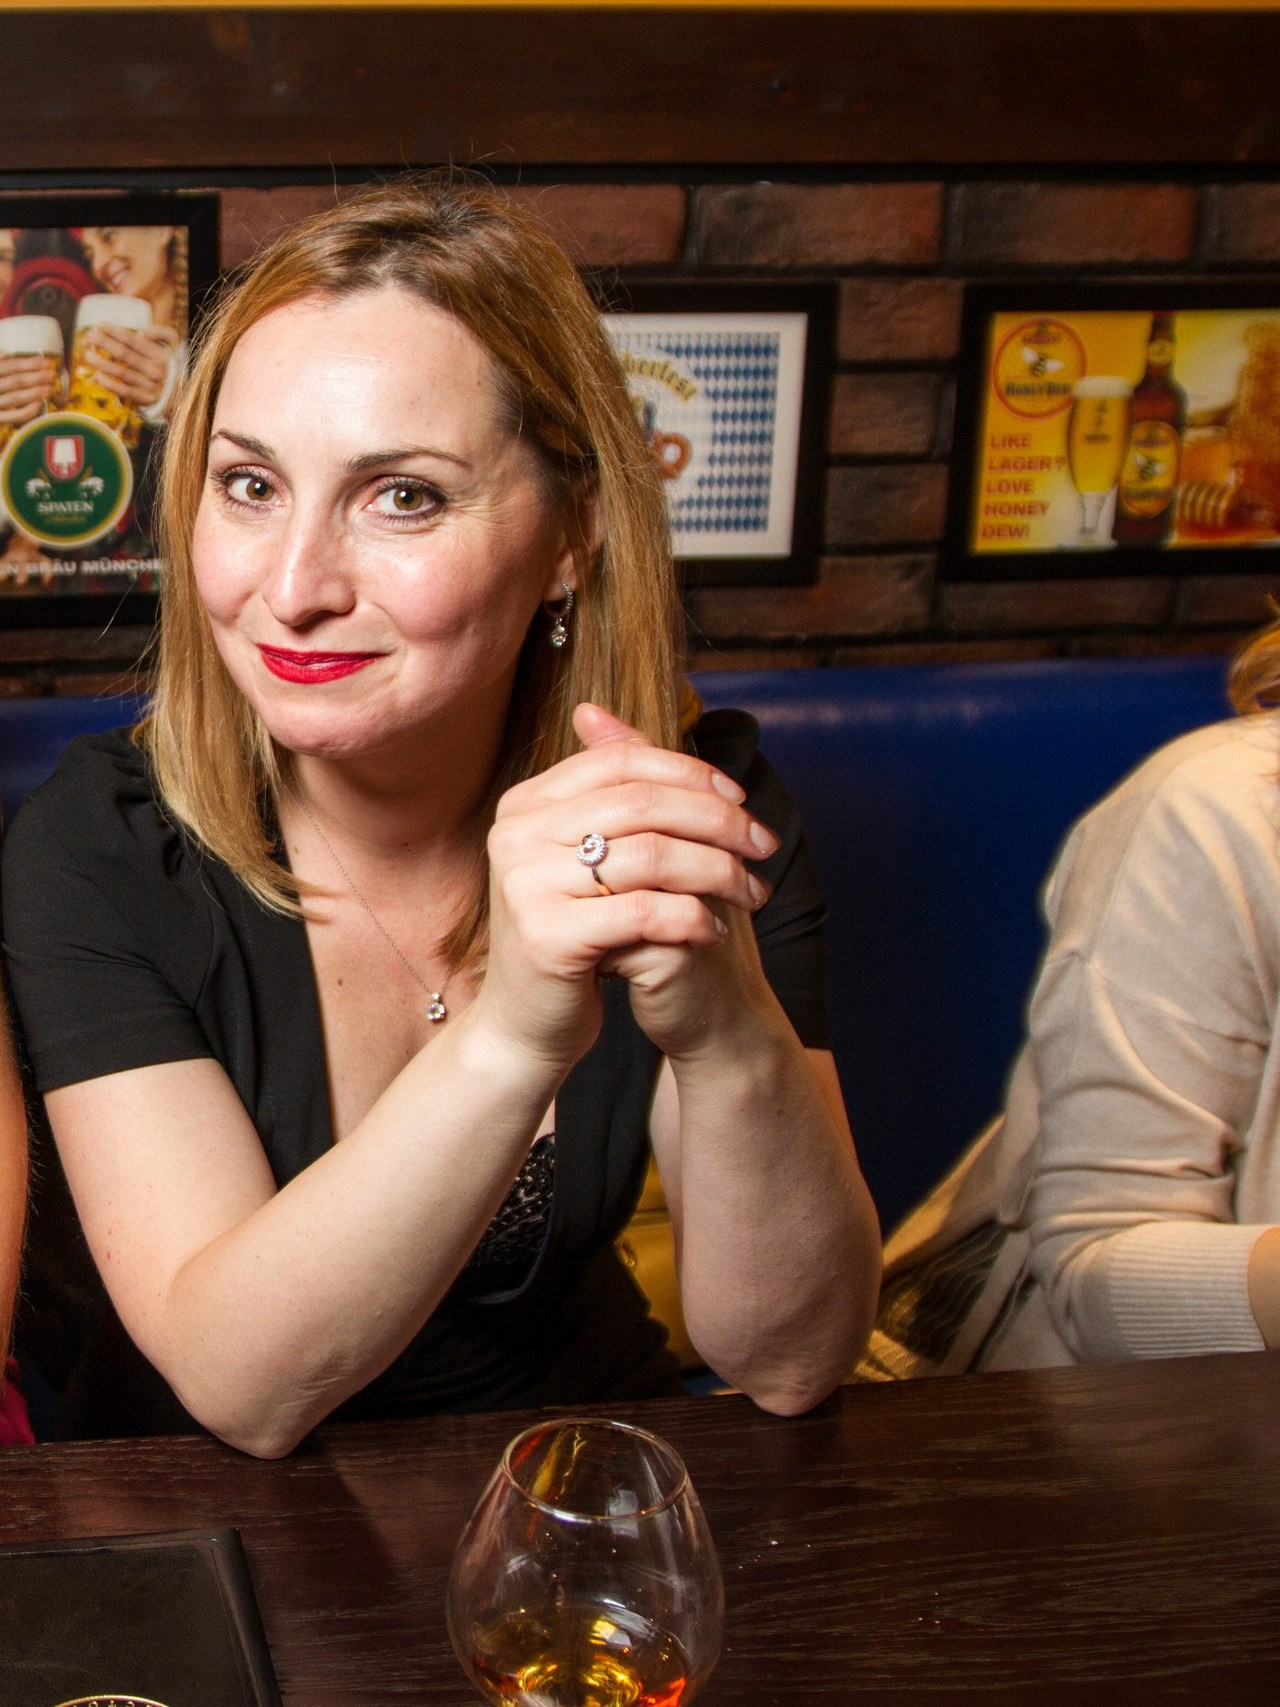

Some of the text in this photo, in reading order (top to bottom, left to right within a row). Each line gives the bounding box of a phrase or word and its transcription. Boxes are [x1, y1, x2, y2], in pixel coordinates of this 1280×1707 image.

[989, 433, 1032, 448] LIKE
[985, 479, 1034, 494] LOVE
[37, 501, 95, 514] SPATEN
[983, 501, 1050, 518] HONEY
[26, 557, 77, 576] BRÄU
[82, 555, 164, 575] MÜNCHE
